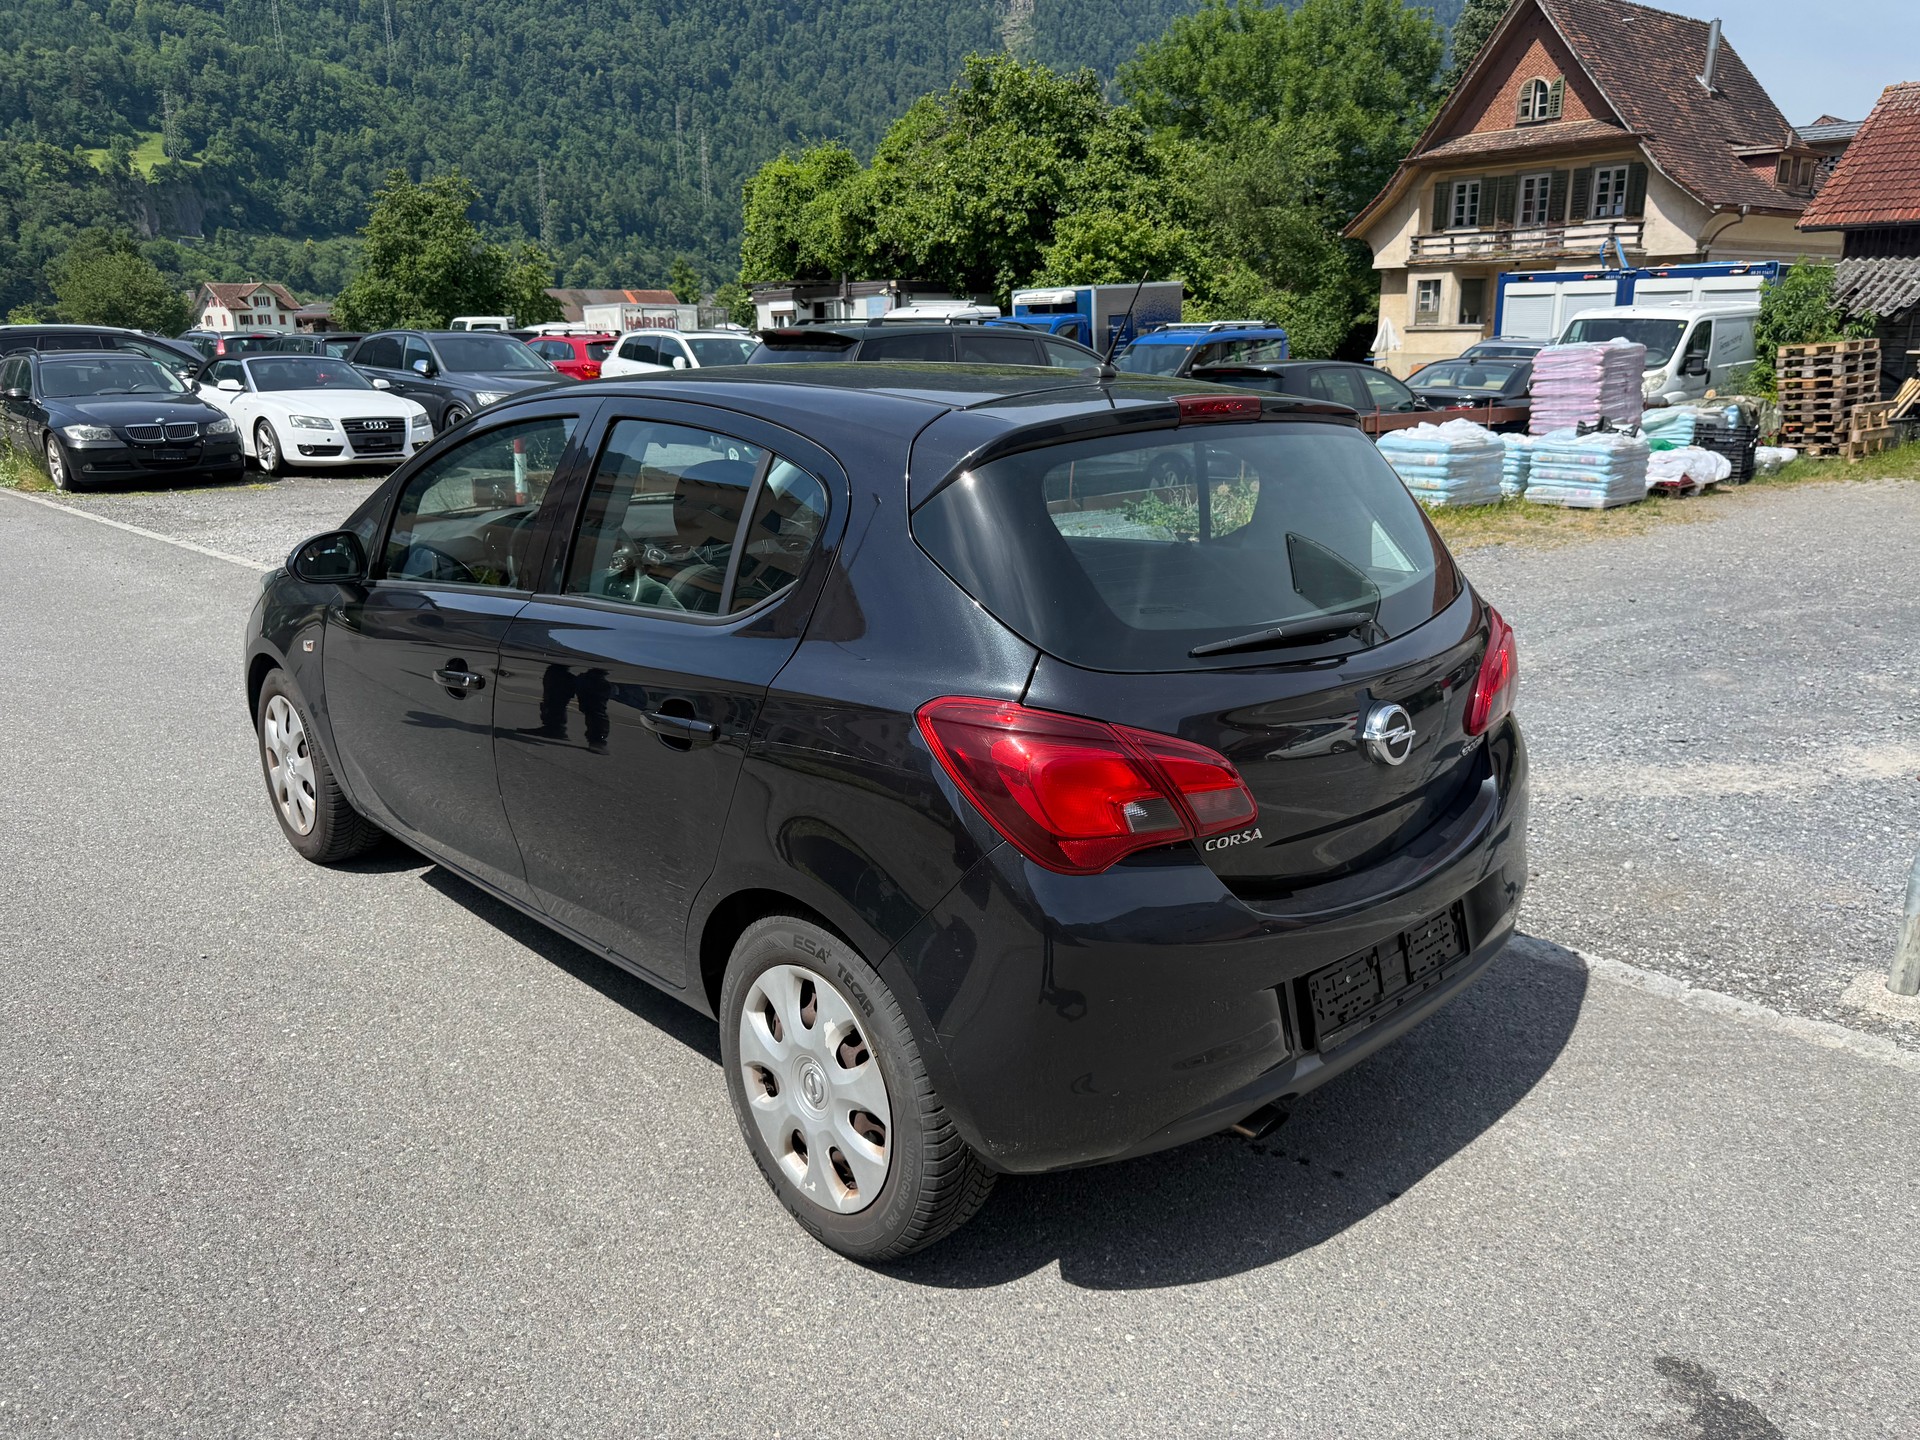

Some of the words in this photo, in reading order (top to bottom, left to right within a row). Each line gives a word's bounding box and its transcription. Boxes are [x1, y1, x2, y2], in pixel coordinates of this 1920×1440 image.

[625, 315, 675, 331] HARIBO
[1204, 827, 1263, 852] CORSA
[793, 934, 832, 965] ESA+
[837, 962, 875, 1018] TECAR
[898, 1139, 915, 1210] SUPERGRIP
[885, 1208, 901, 1231] PRO
